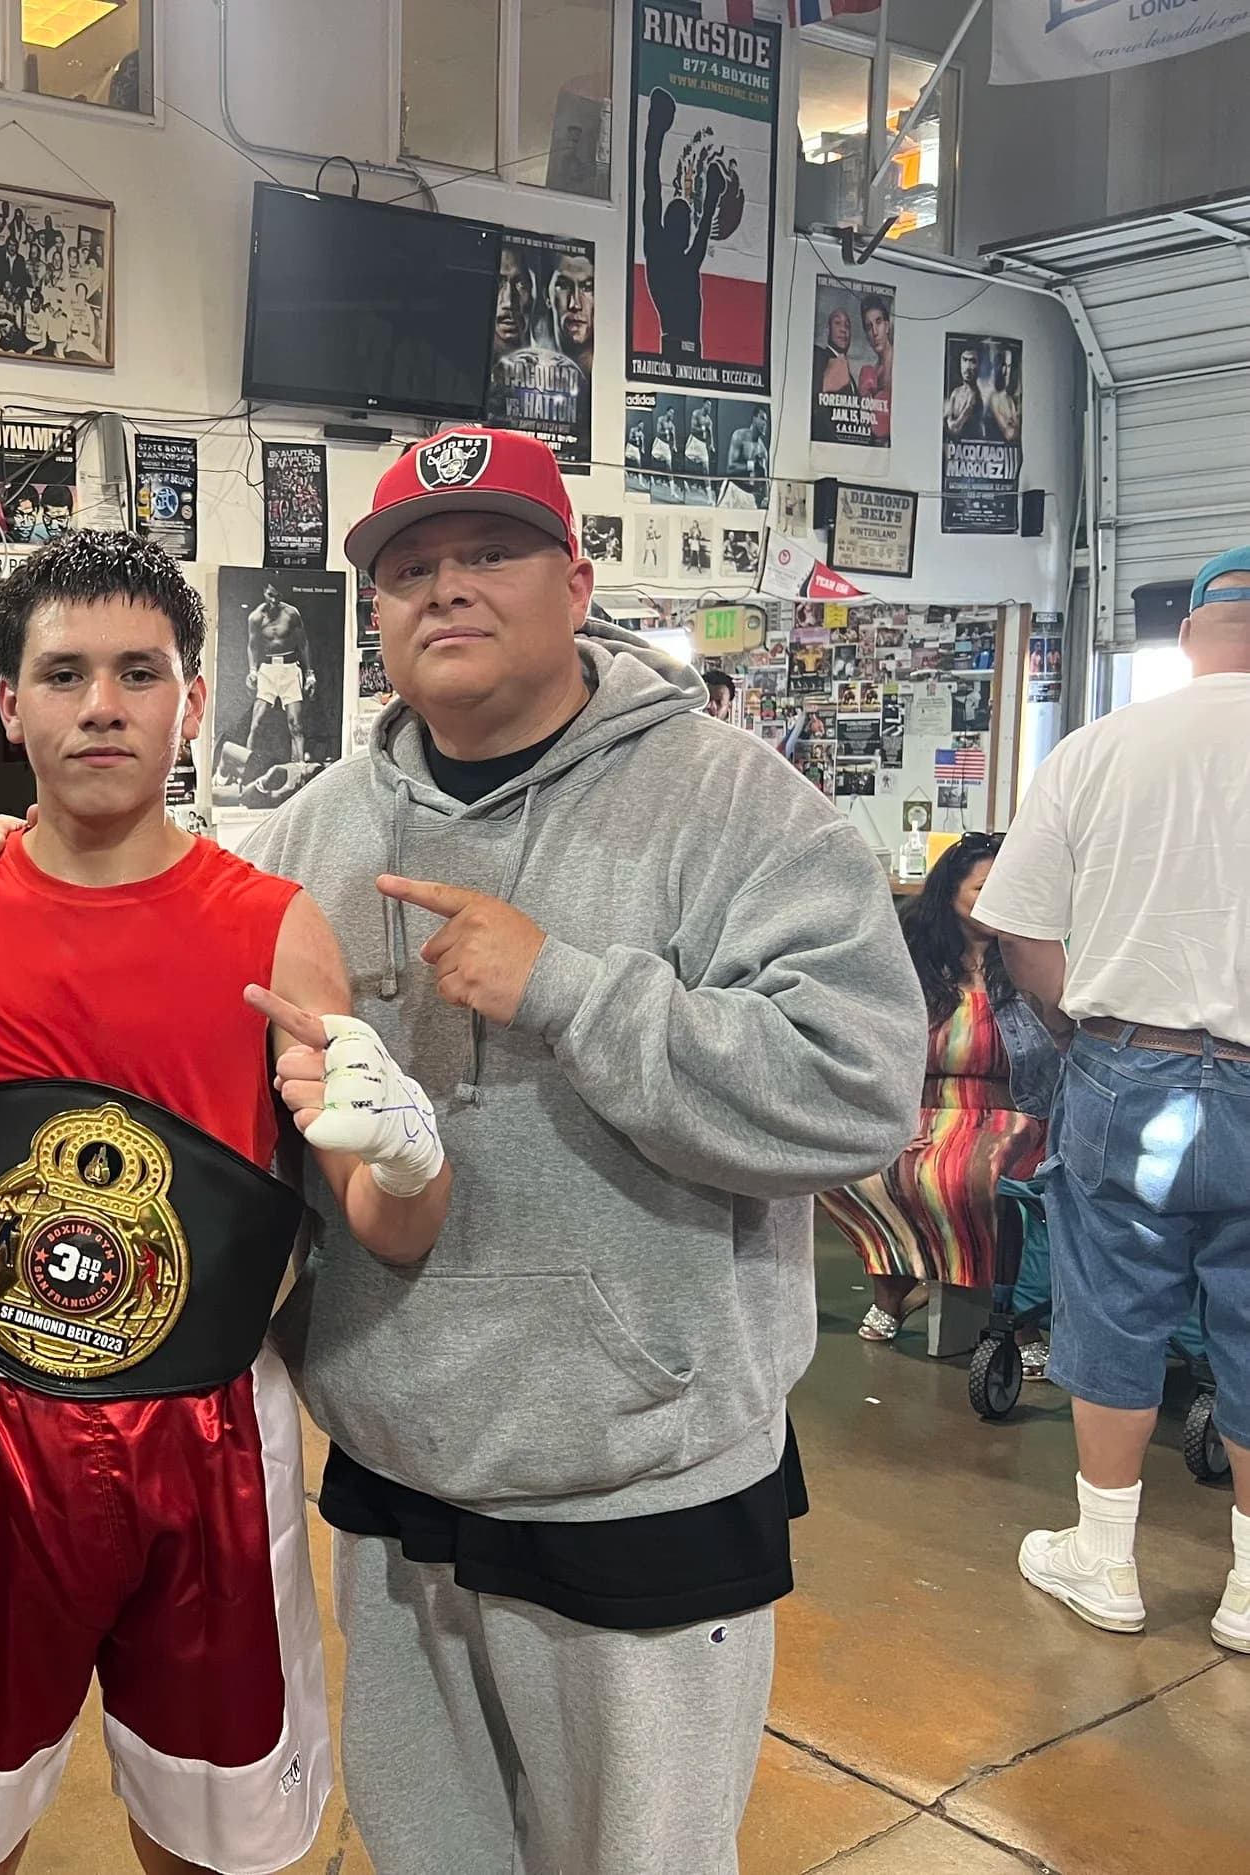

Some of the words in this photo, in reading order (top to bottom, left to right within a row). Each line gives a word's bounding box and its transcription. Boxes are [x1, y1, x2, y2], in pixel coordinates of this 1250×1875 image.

[643, 7, 770, 69] RINGSIDE
[524, 391, 577, 423] HATTON
[626, 394, 656, 407] adidas
[425, 439, 483, 457] RAIDERS
[947, 443, 1004, 462] PACQUIAO
[946, 460, 1004, 479] MARQUEZ
[850, 491, 910, 510] DIAMOND
[860, 506, 902, 523] BELTS
[849, 526, 897, 539] WINTERLAND
[815, 574, 836, 591] TEAM
[835, 582, 849, 595] USA
[705, 609, 737, 639] EXIT
[47, 1224, 92, 1242] BOXING
[95, 1234, 115, 1259] GYM
[78, 1268, 99, 1284] ST
[34, 1265, 49, 1290] SAN
[47, 1286, 108, 1307] FRANCISCO
[0, 1305, 14, 1320] SF
[14, 1310, 67, 1336] DIAMOND
[66, 1324, 93, 1343] BELT
[92, 1332, 123, 1352] 2023
